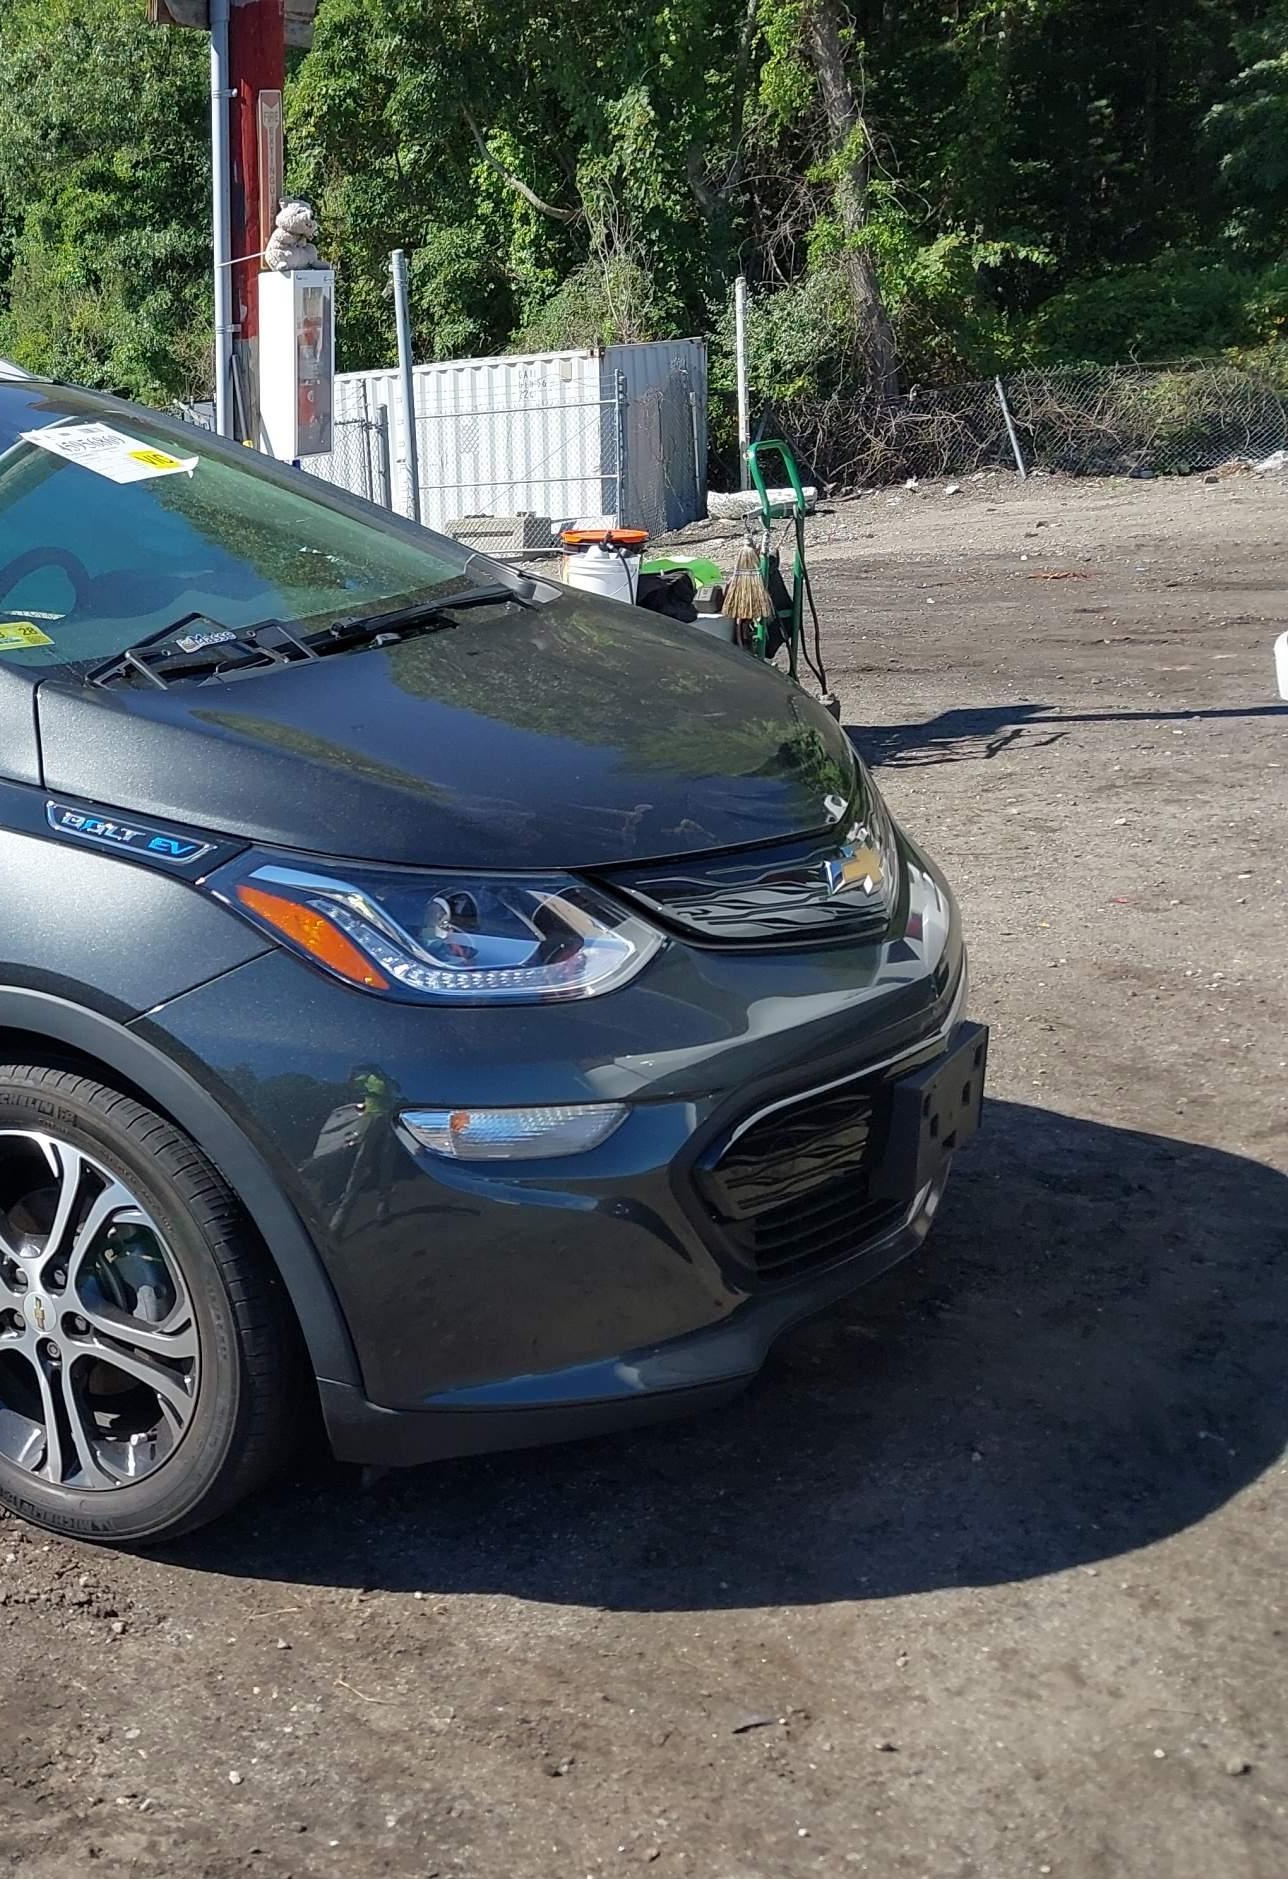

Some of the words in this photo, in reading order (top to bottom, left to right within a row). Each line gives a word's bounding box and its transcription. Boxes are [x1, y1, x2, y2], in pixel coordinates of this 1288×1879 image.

[264, 111, 279, 123] FIRE
[18, 626, 38, 636] 28
[61, 812, 146, 842] BOLT
[147, 836, 195, 855] EV
